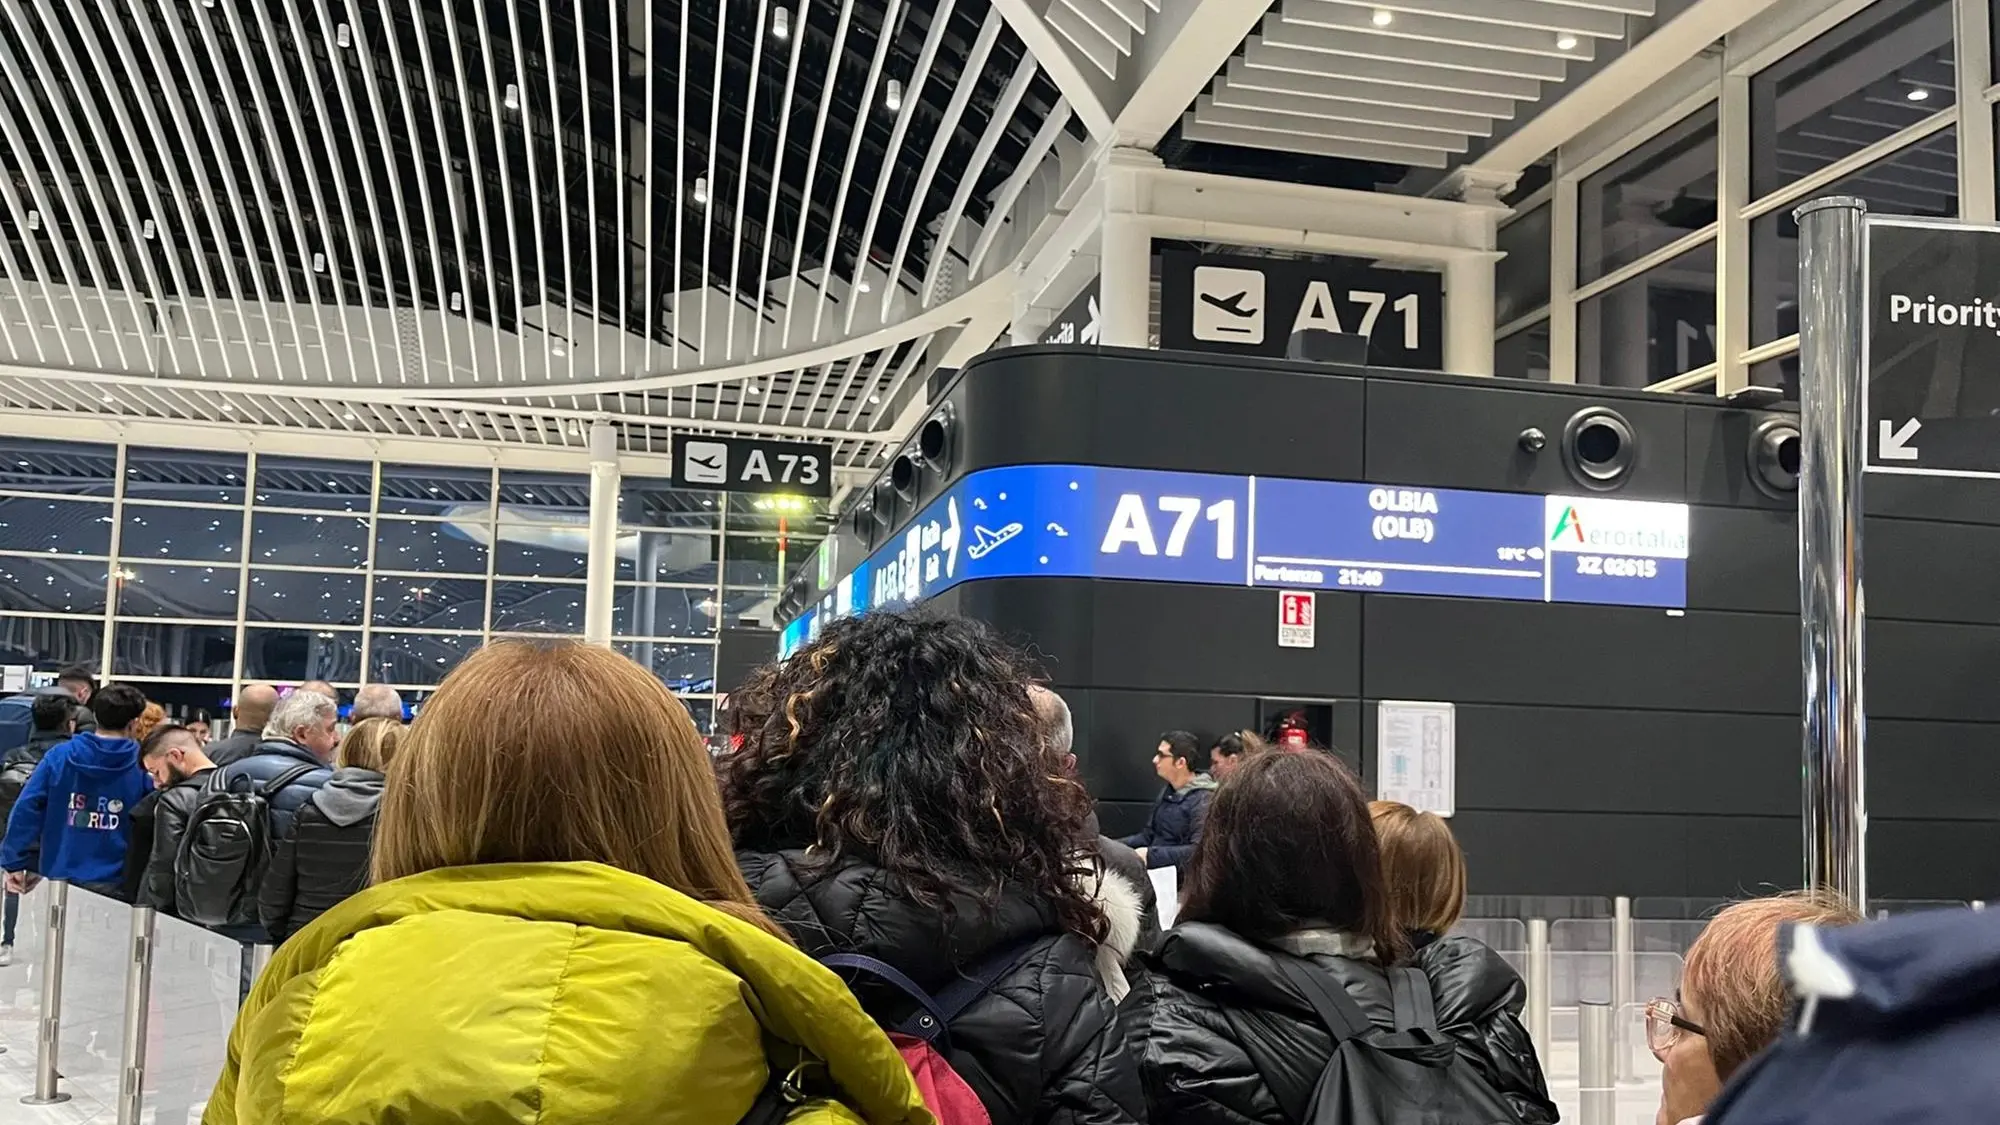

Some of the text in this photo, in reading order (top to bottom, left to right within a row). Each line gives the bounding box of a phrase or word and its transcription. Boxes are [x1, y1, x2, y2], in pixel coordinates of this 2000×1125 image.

[1292, 281, 1420, 349] A71
[1891, 295, 2000, 336] Priorit
[1368, 488, 1439, 514] OLBIA
[1101, 494, 1235, 559] A71
[1372, 515, 1434, 543] (OLB)
[1577, 555, 1603, 575] XZ
